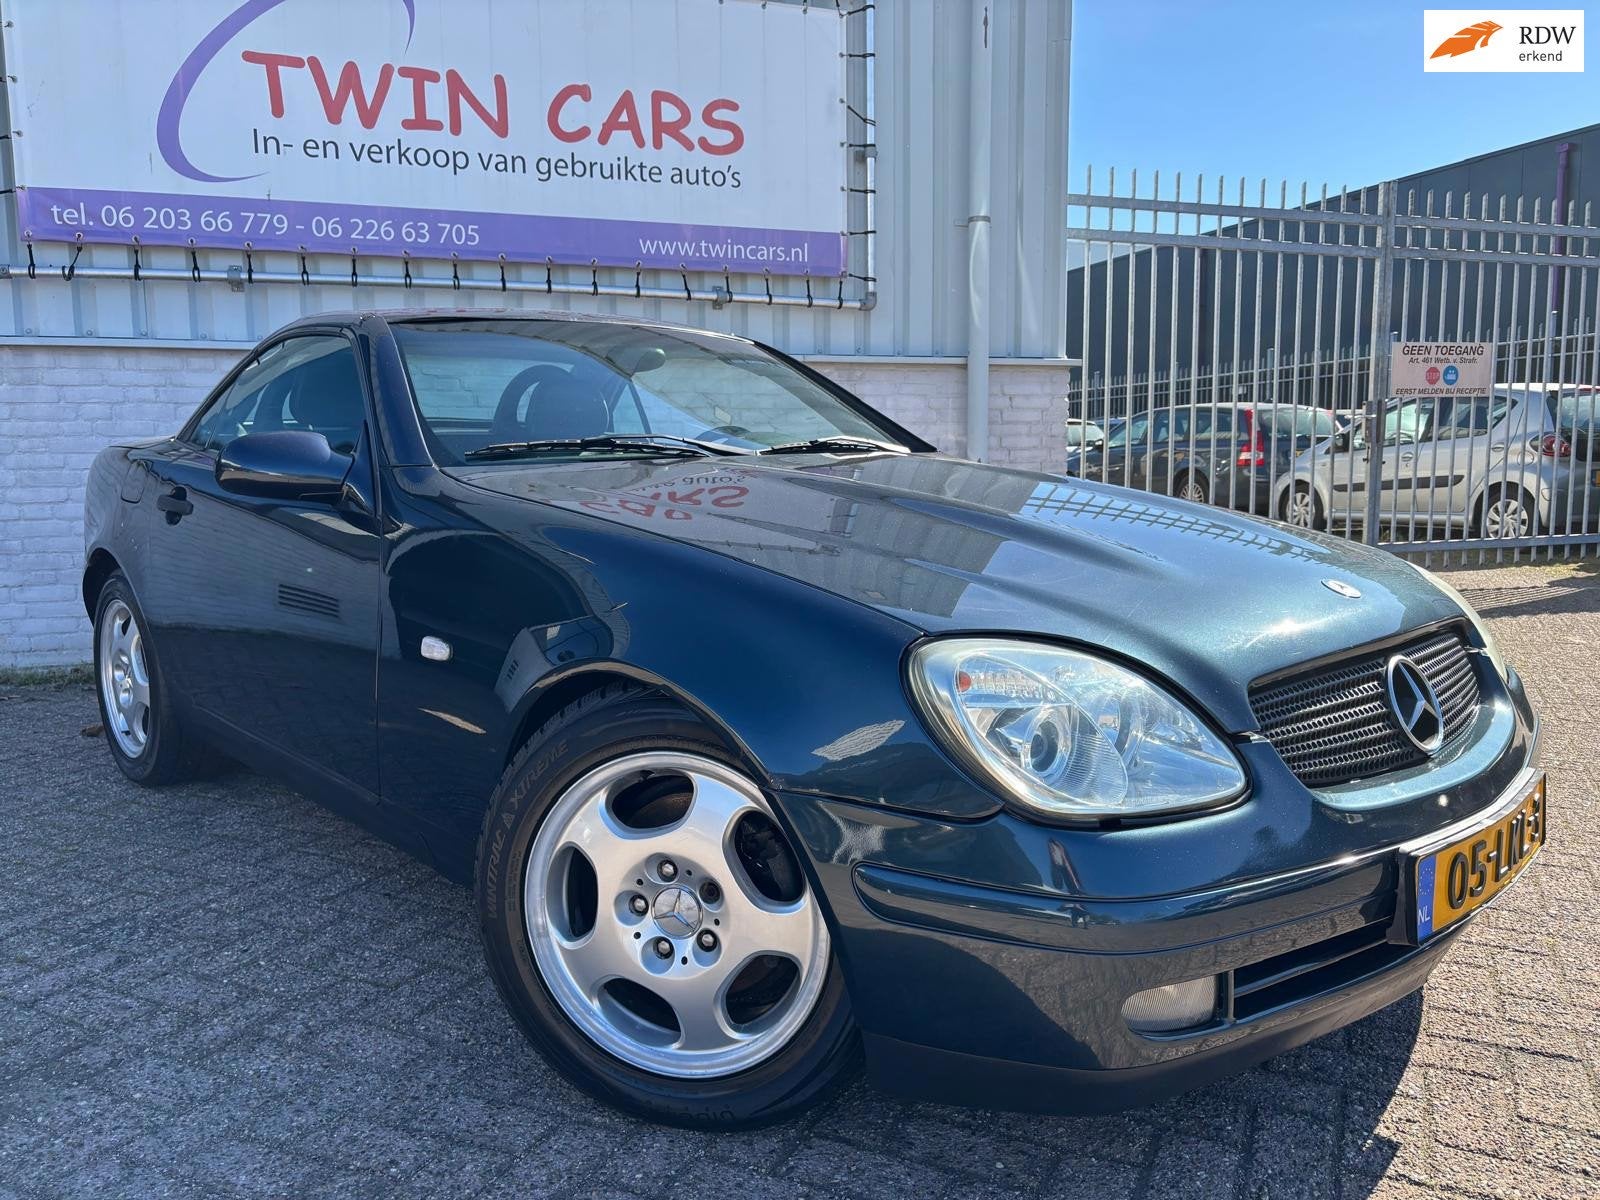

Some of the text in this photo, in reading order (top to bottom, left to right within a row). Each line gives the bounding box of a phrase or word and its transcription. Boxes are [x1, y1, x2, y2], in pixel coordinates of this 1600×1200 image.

[241, 50, 745, 156] TWIN CARS
[253, 128, 742, 188] In- en verkoop van gebruikte auto's
[51, 202, 94, 226] tel.
[101, 206, 135, 228] 06
[143, 207, 192, 230] 203
[201, 210, 233, 233] 66
[240, 212, 288, 235] 779
[312, 217, 342, 239] 06
[350, 218, 394, 241] 226
[402, 221, 430, 243] 63
[438, 223, 480, 246] 705
[639, 238, 808, 262] www.twincars.nl
[1402, 345, 1485, 356] GEEN TOEGANG
[1456, 387, 1487, 395] RECEPTIE
[1417, 905, 1431, 926] NL
